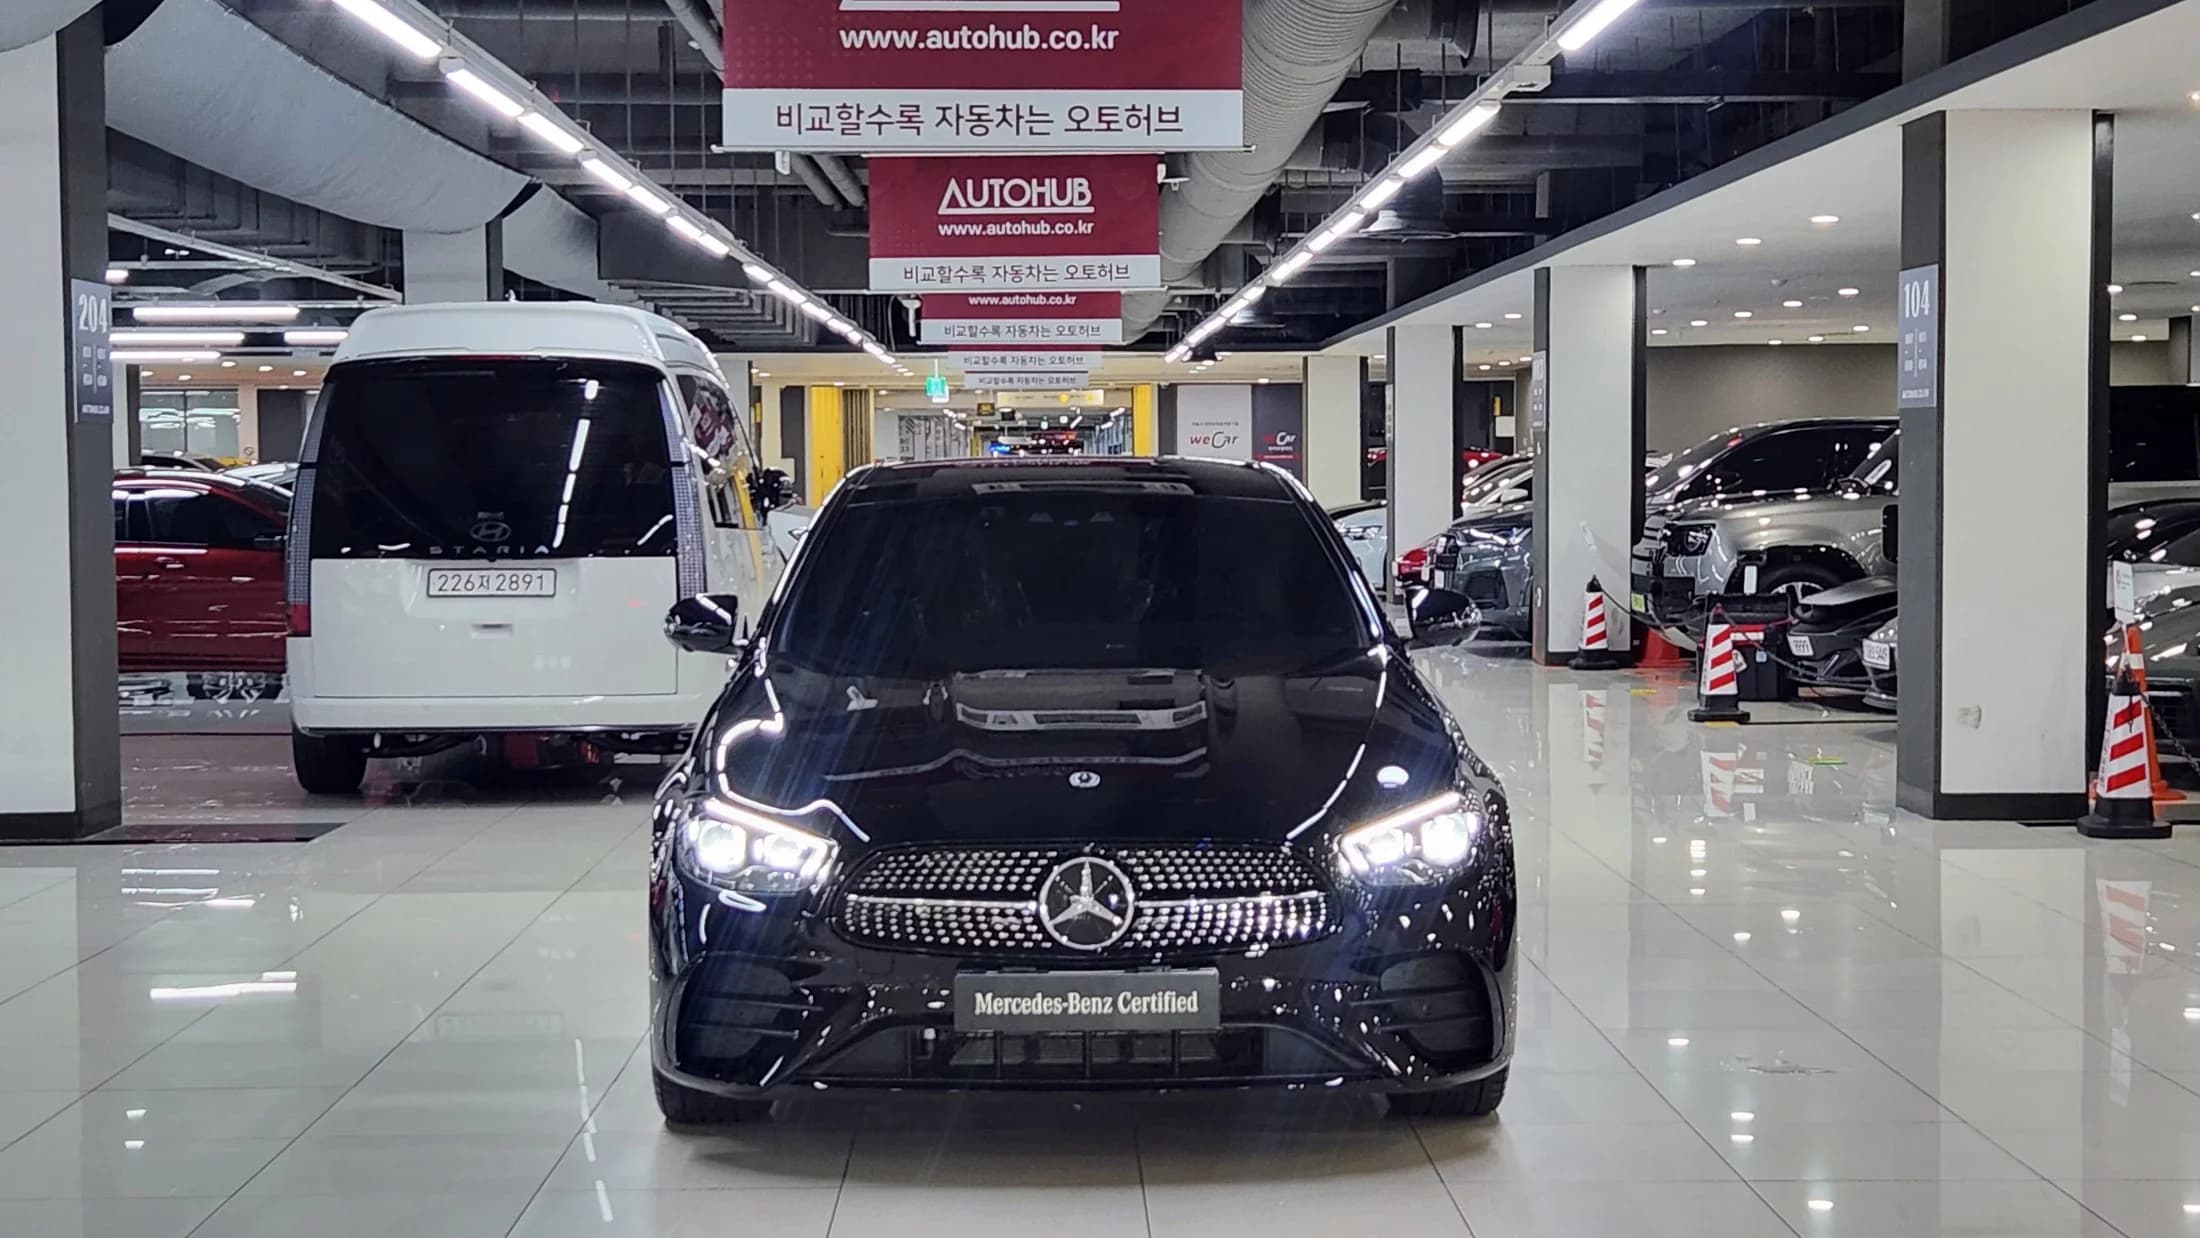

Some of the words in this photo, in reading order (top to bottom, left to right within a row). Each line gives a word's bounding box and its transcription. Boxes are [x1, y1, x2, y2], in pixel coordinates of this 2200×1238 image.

[839, 24, 1120, 50] www.autohub.co.kr
[776, 102, 925, 136] 비교할수록
[934, 103, 1055, 136] 자동차는
[1064, 104, 1184, 134] 오토허브
[938, 177, 1095, 214] AUTOHUB
[938, 220, 1095, 236] www.autohub.co.kr
[903, 265, 987, 284] 비교할수록
[992, 264, 1059, 283] 자동차는
[1063, 263, 1131, 282] 오토허브
[968, 294, 1077, 306] www.autohub.co.kr
[1903, 280, 1930, 319] 104
[79, 293, 108, 333] 204
[944, 325, 1001, 338] 비교할수록
[1005, 325, 1052, 338] 자동차는
[1055, 324, 1102, 337] 오토허브
[429, 545, 550, 555] STARIA
[974, 991, 1113, 1016] Mercedes-Benz
[1117, 990, 1199, 1013] Certified
